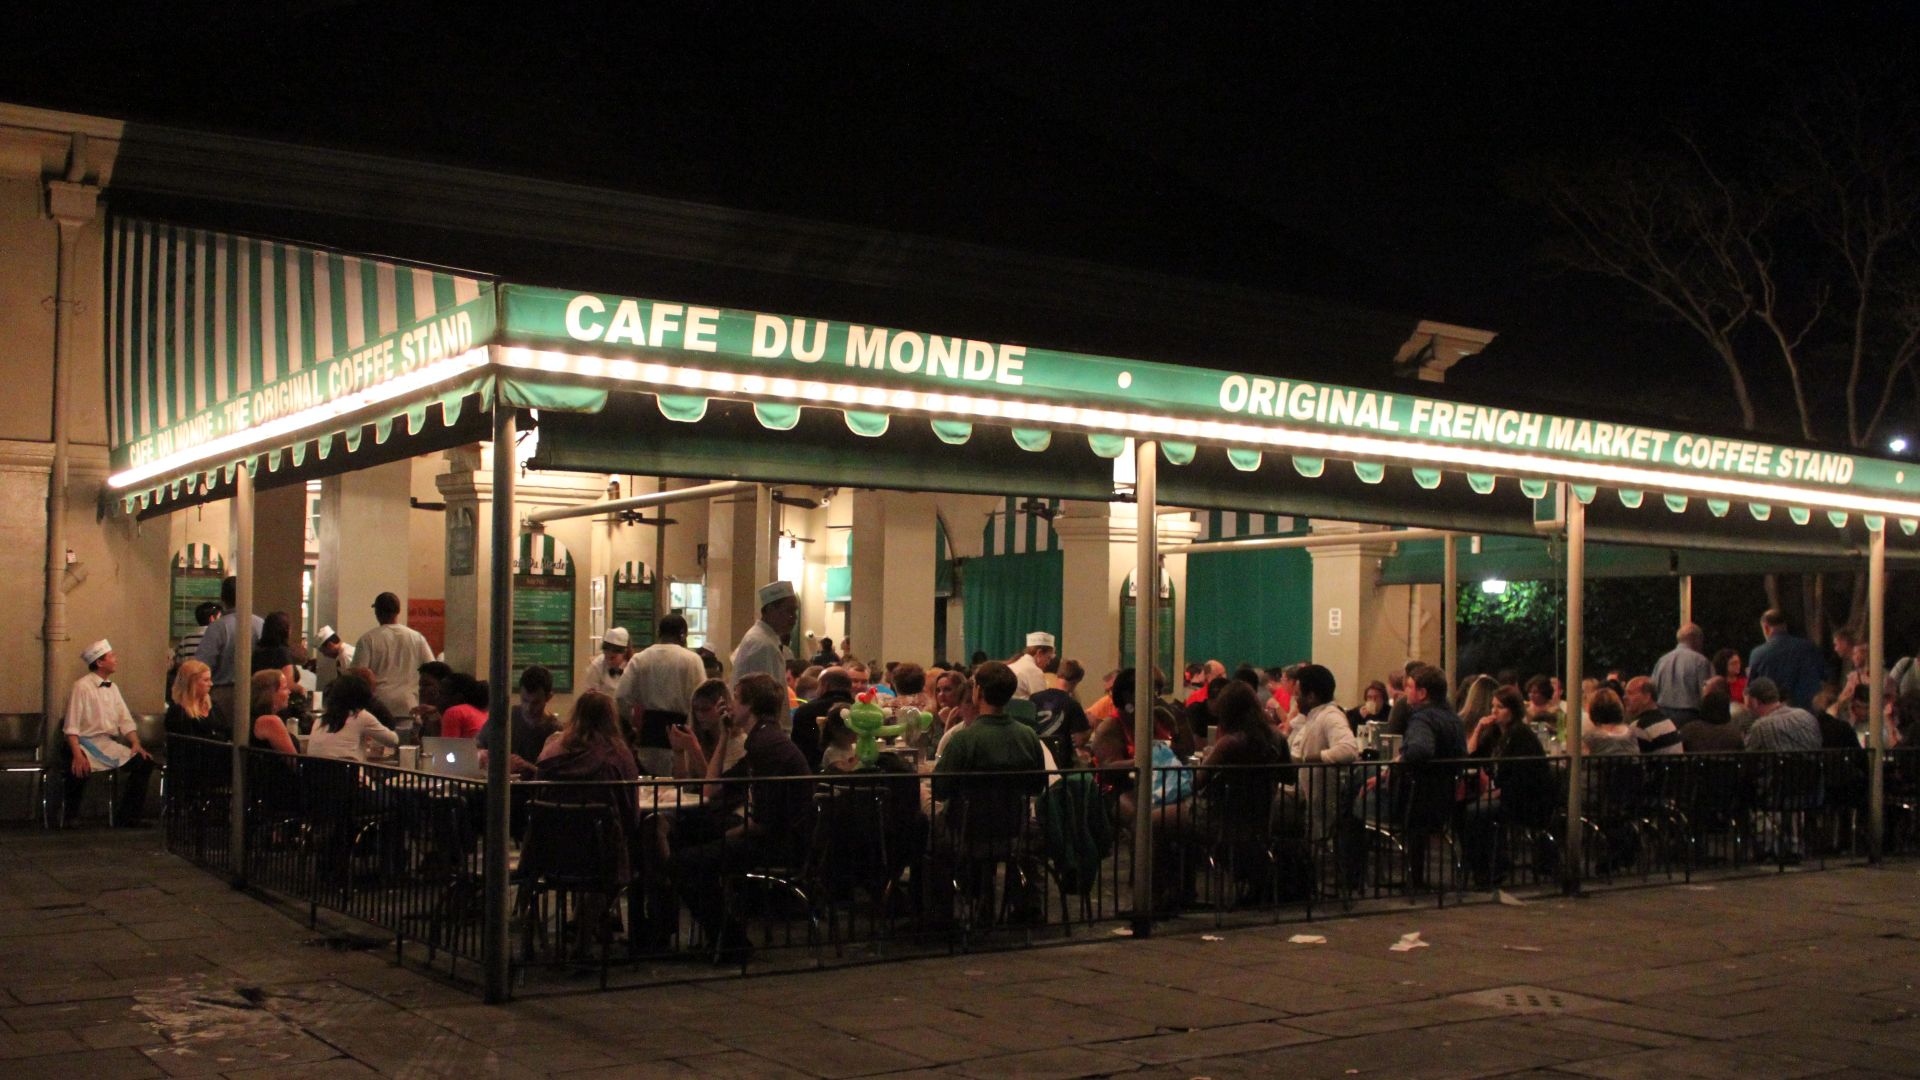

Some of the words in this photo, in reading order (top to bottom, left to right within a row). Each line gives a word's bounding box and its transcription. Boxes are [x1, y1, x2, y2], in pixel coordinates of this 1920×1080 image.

[129, 436, 154, 467] CAFE
[157, 429, 174, 457] DU
[223, 396, 250, 435] THE
[253, 369, 324, 424] ORIGINAL
[327, 339, 395, 399] COFFEE
[400, 311, 473, 373] STAND
[565, 294, 720, 352] CAFE
[752, 314, 829, 362] DU
[845, 325, 1027, 385] MONDE
[1219, 375, 1400, 431] ORIGINAL
[1410, 399, 1544, 448] FRENCH
[1546, 417, 1670, 461] MARKET
[1673, 435, 1774, 475] COFFEE
[1776, 449, 1854, 484] STAND
